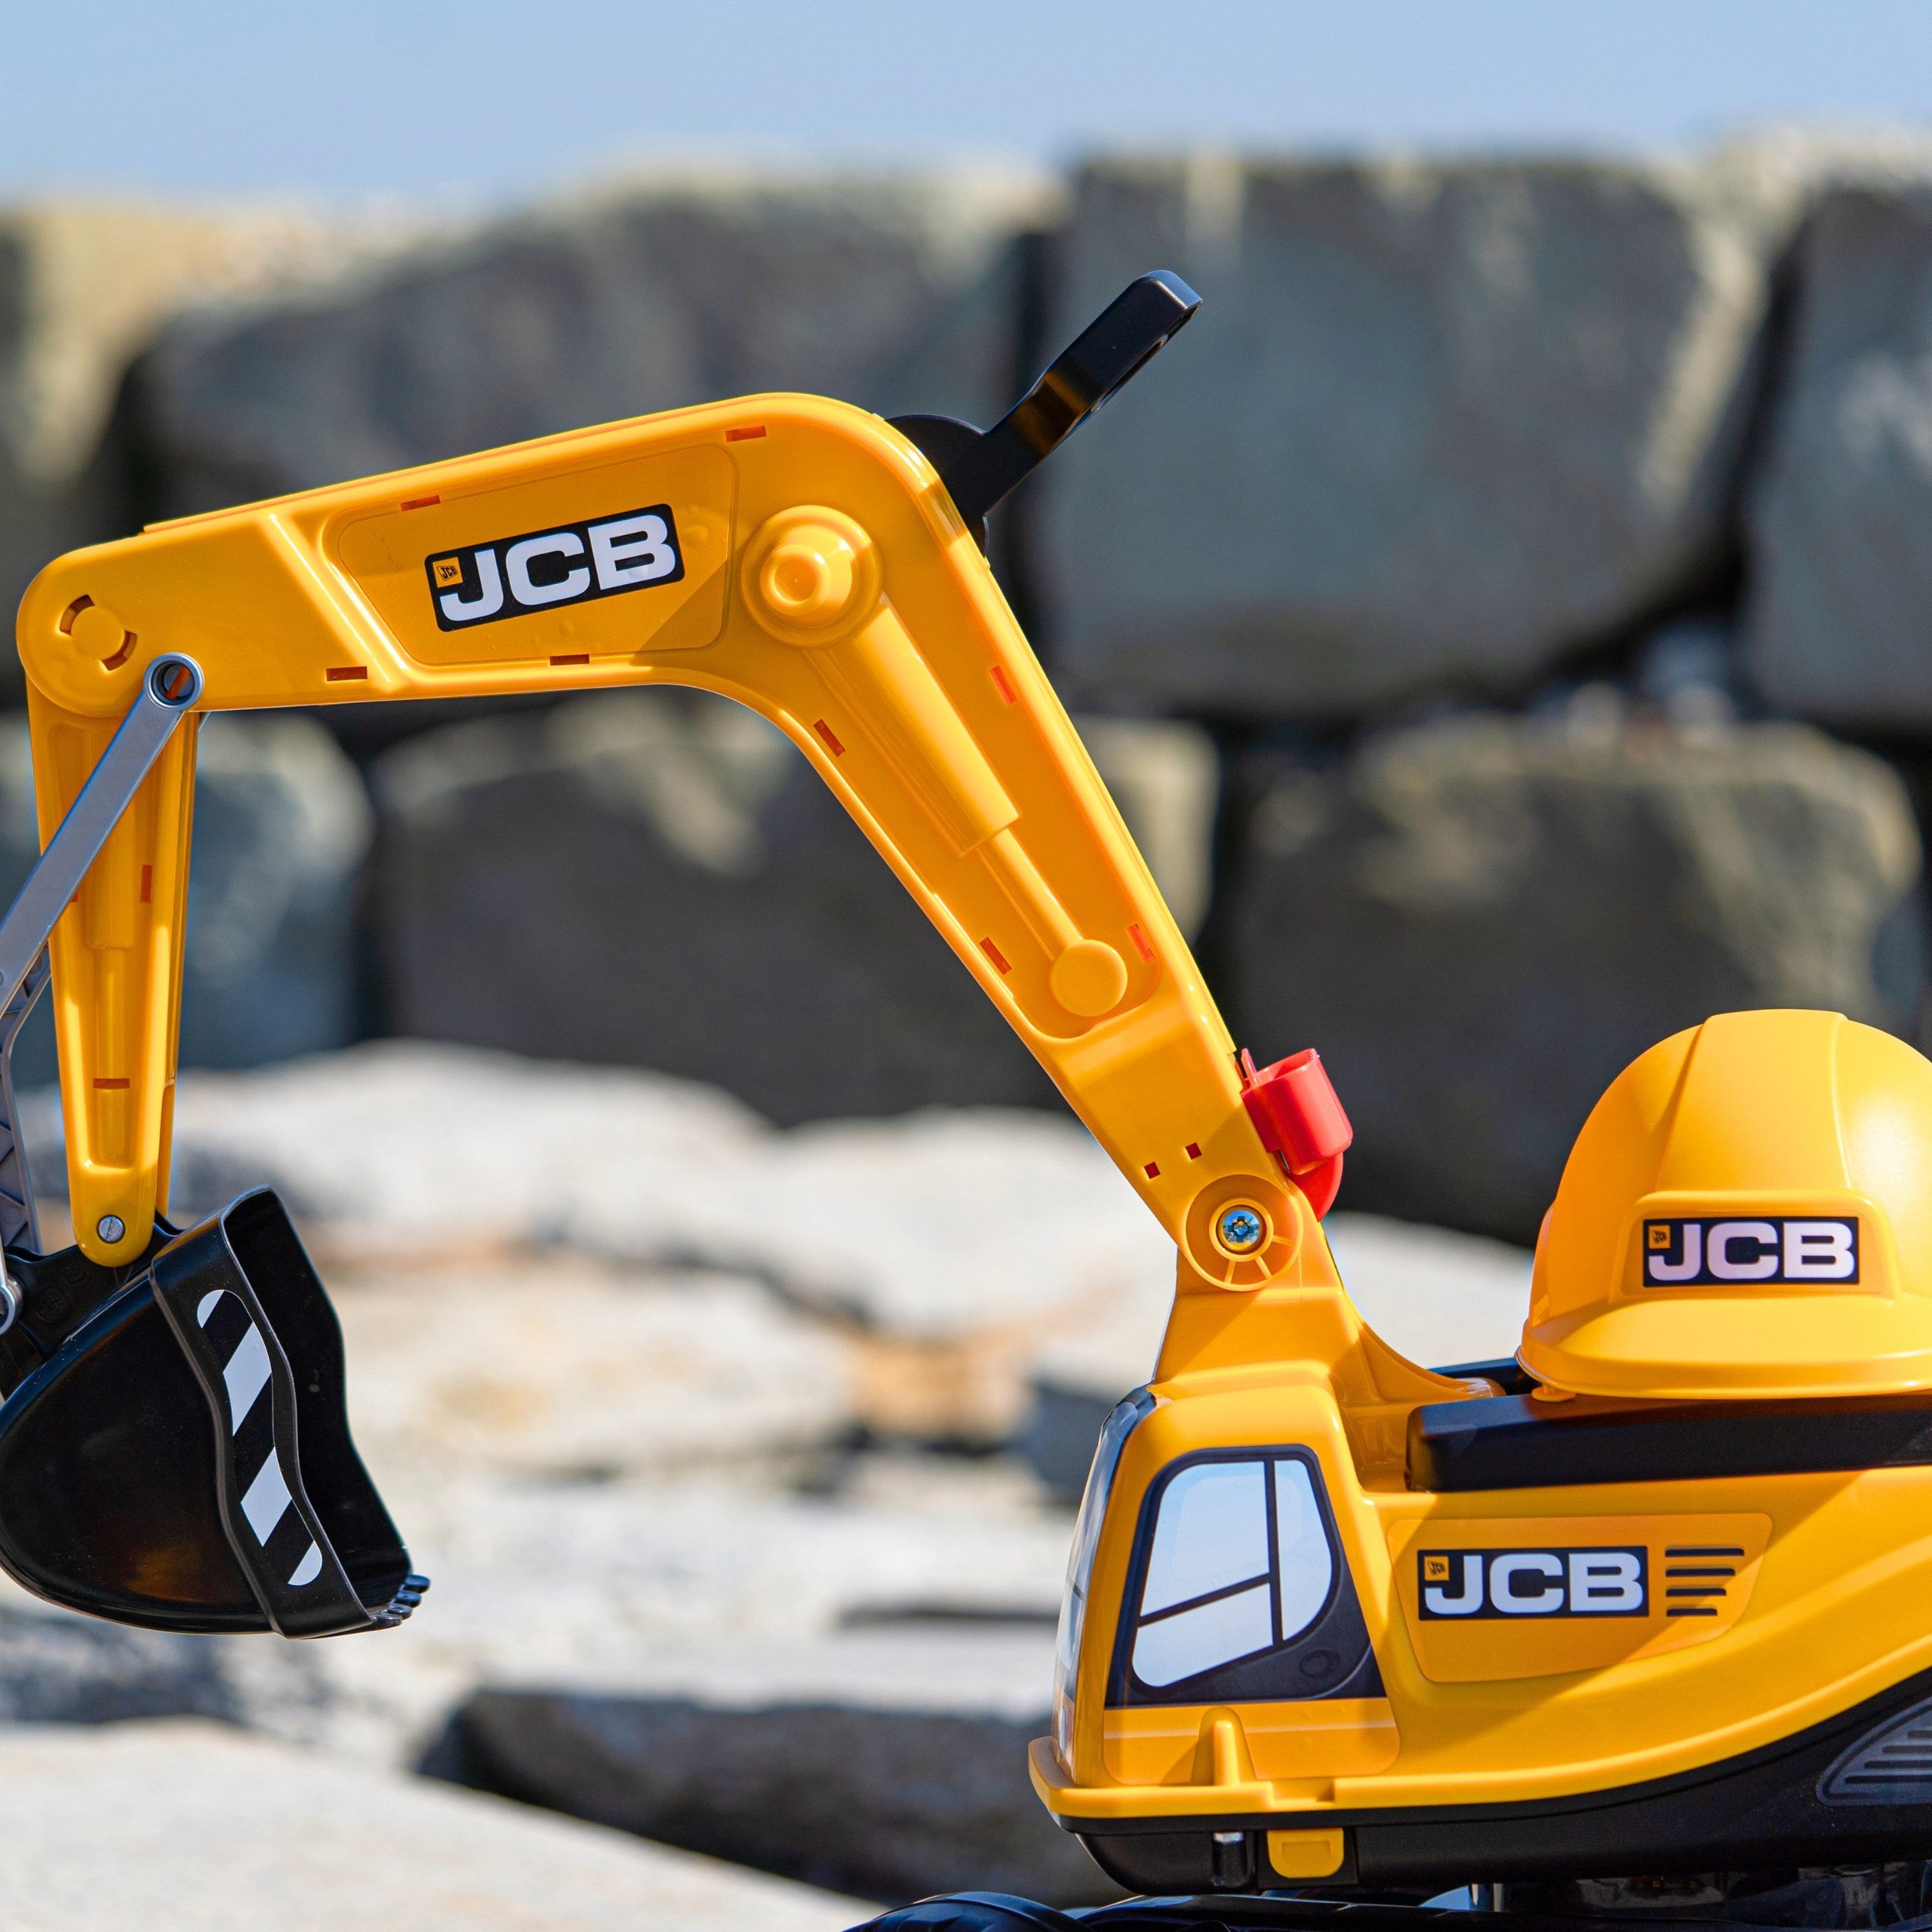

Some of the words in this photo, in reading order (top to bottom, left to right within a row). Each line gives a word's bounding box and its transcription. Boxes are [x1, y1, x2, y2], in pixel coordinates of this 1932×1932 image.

[439, 515, 675, 621] JCB
[440, 567, 457, 580] JCB
[1648, 1221, 1854, 1281] JCB
[1425, 1553, 1643, 1614] JCB
